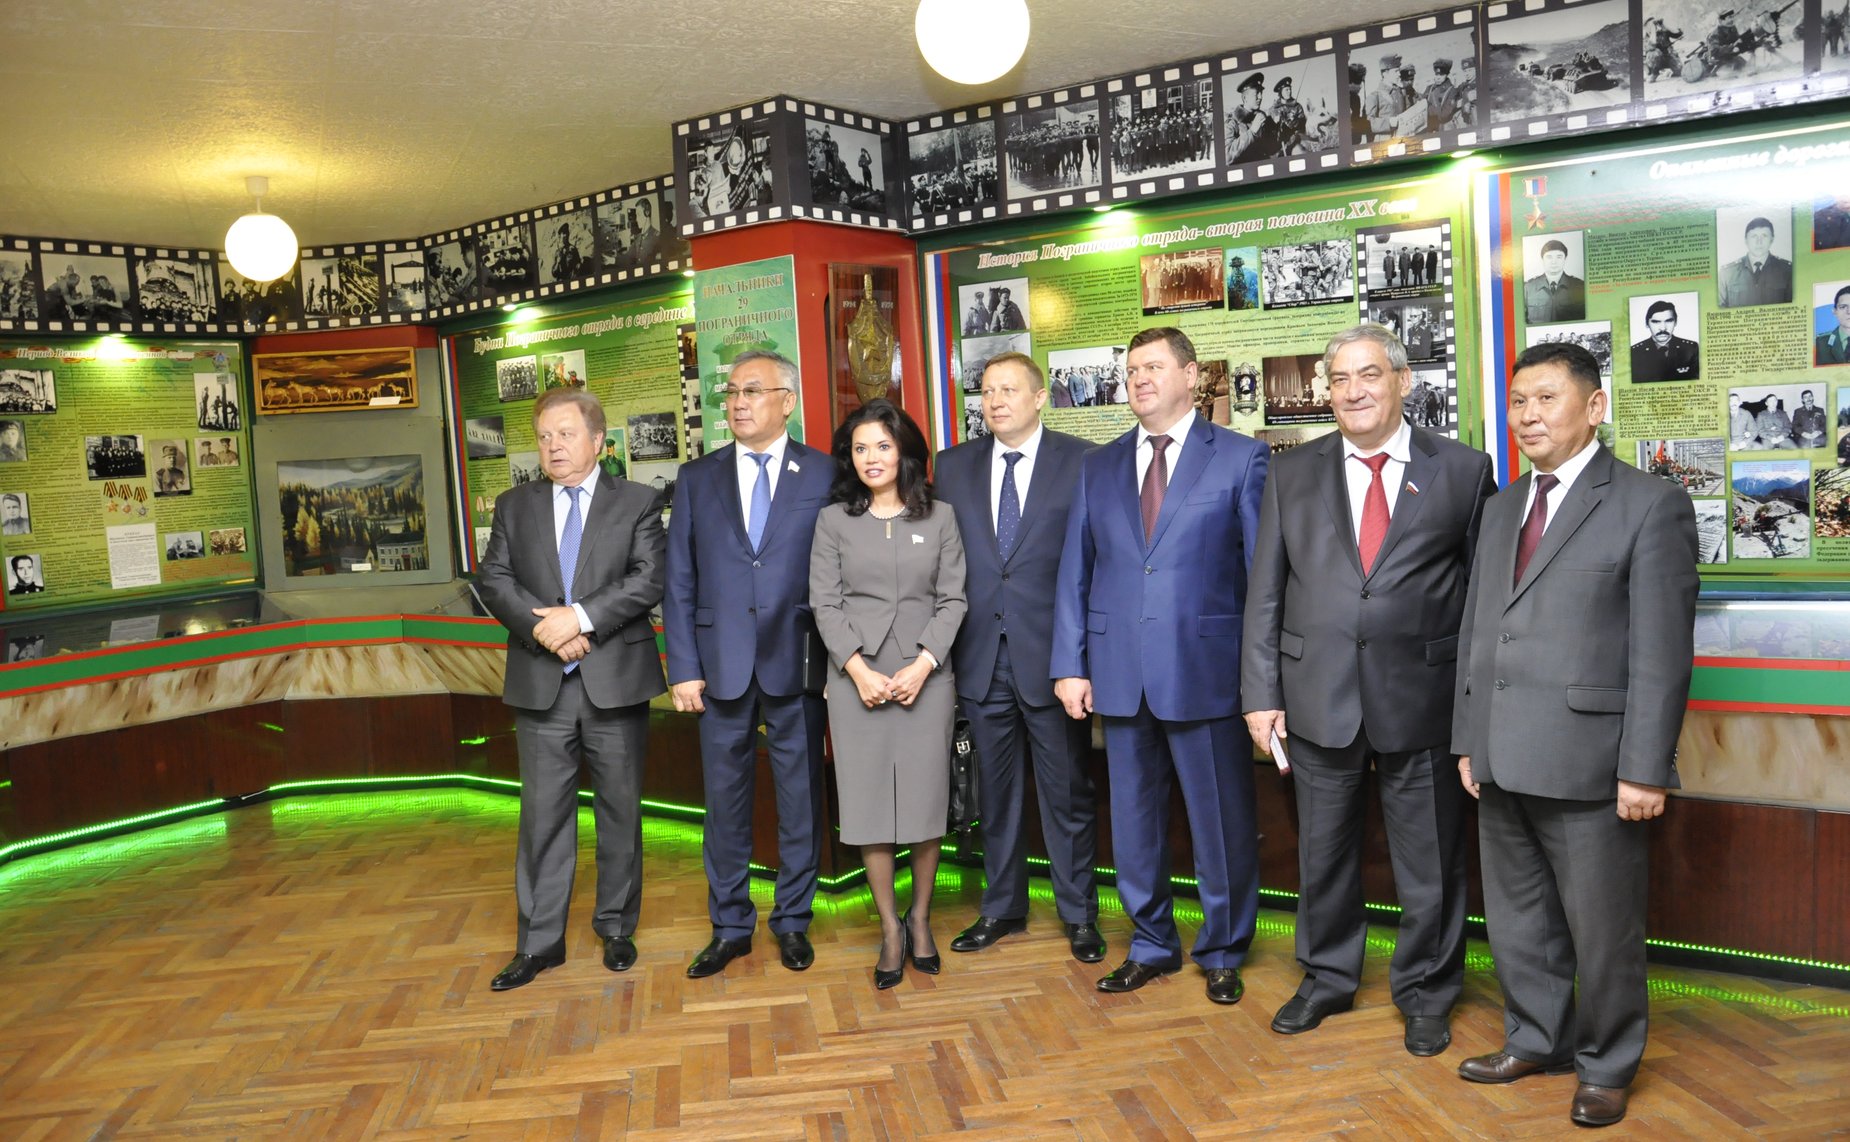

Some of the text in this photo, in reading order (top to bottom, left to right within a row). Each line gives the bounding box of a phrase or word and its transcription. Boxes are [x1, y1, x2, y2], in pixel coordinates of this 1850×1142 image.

[977, 250, 1038, 269] История
[1206, 217, 1263, 239] вторая
[1267, 206, 1346, 229] половина
[702, 273, 784, 299] НАЧАЛЬНИКИ
[737, 297, 748, 310] 29
[474, 336, 504, 356] Будни
[505, 325, 580, 349] Пограничного
[581, 312, 624, 337] отряда
[625, 315, 632, 328] в
[634, 306, 687, 329] середине
[698, 307, 794, 333] ПОГРАНИЧНОГО
[722, 329, 768, 346] ОТРЯДА
[55, 348, 97, 358] Вели
